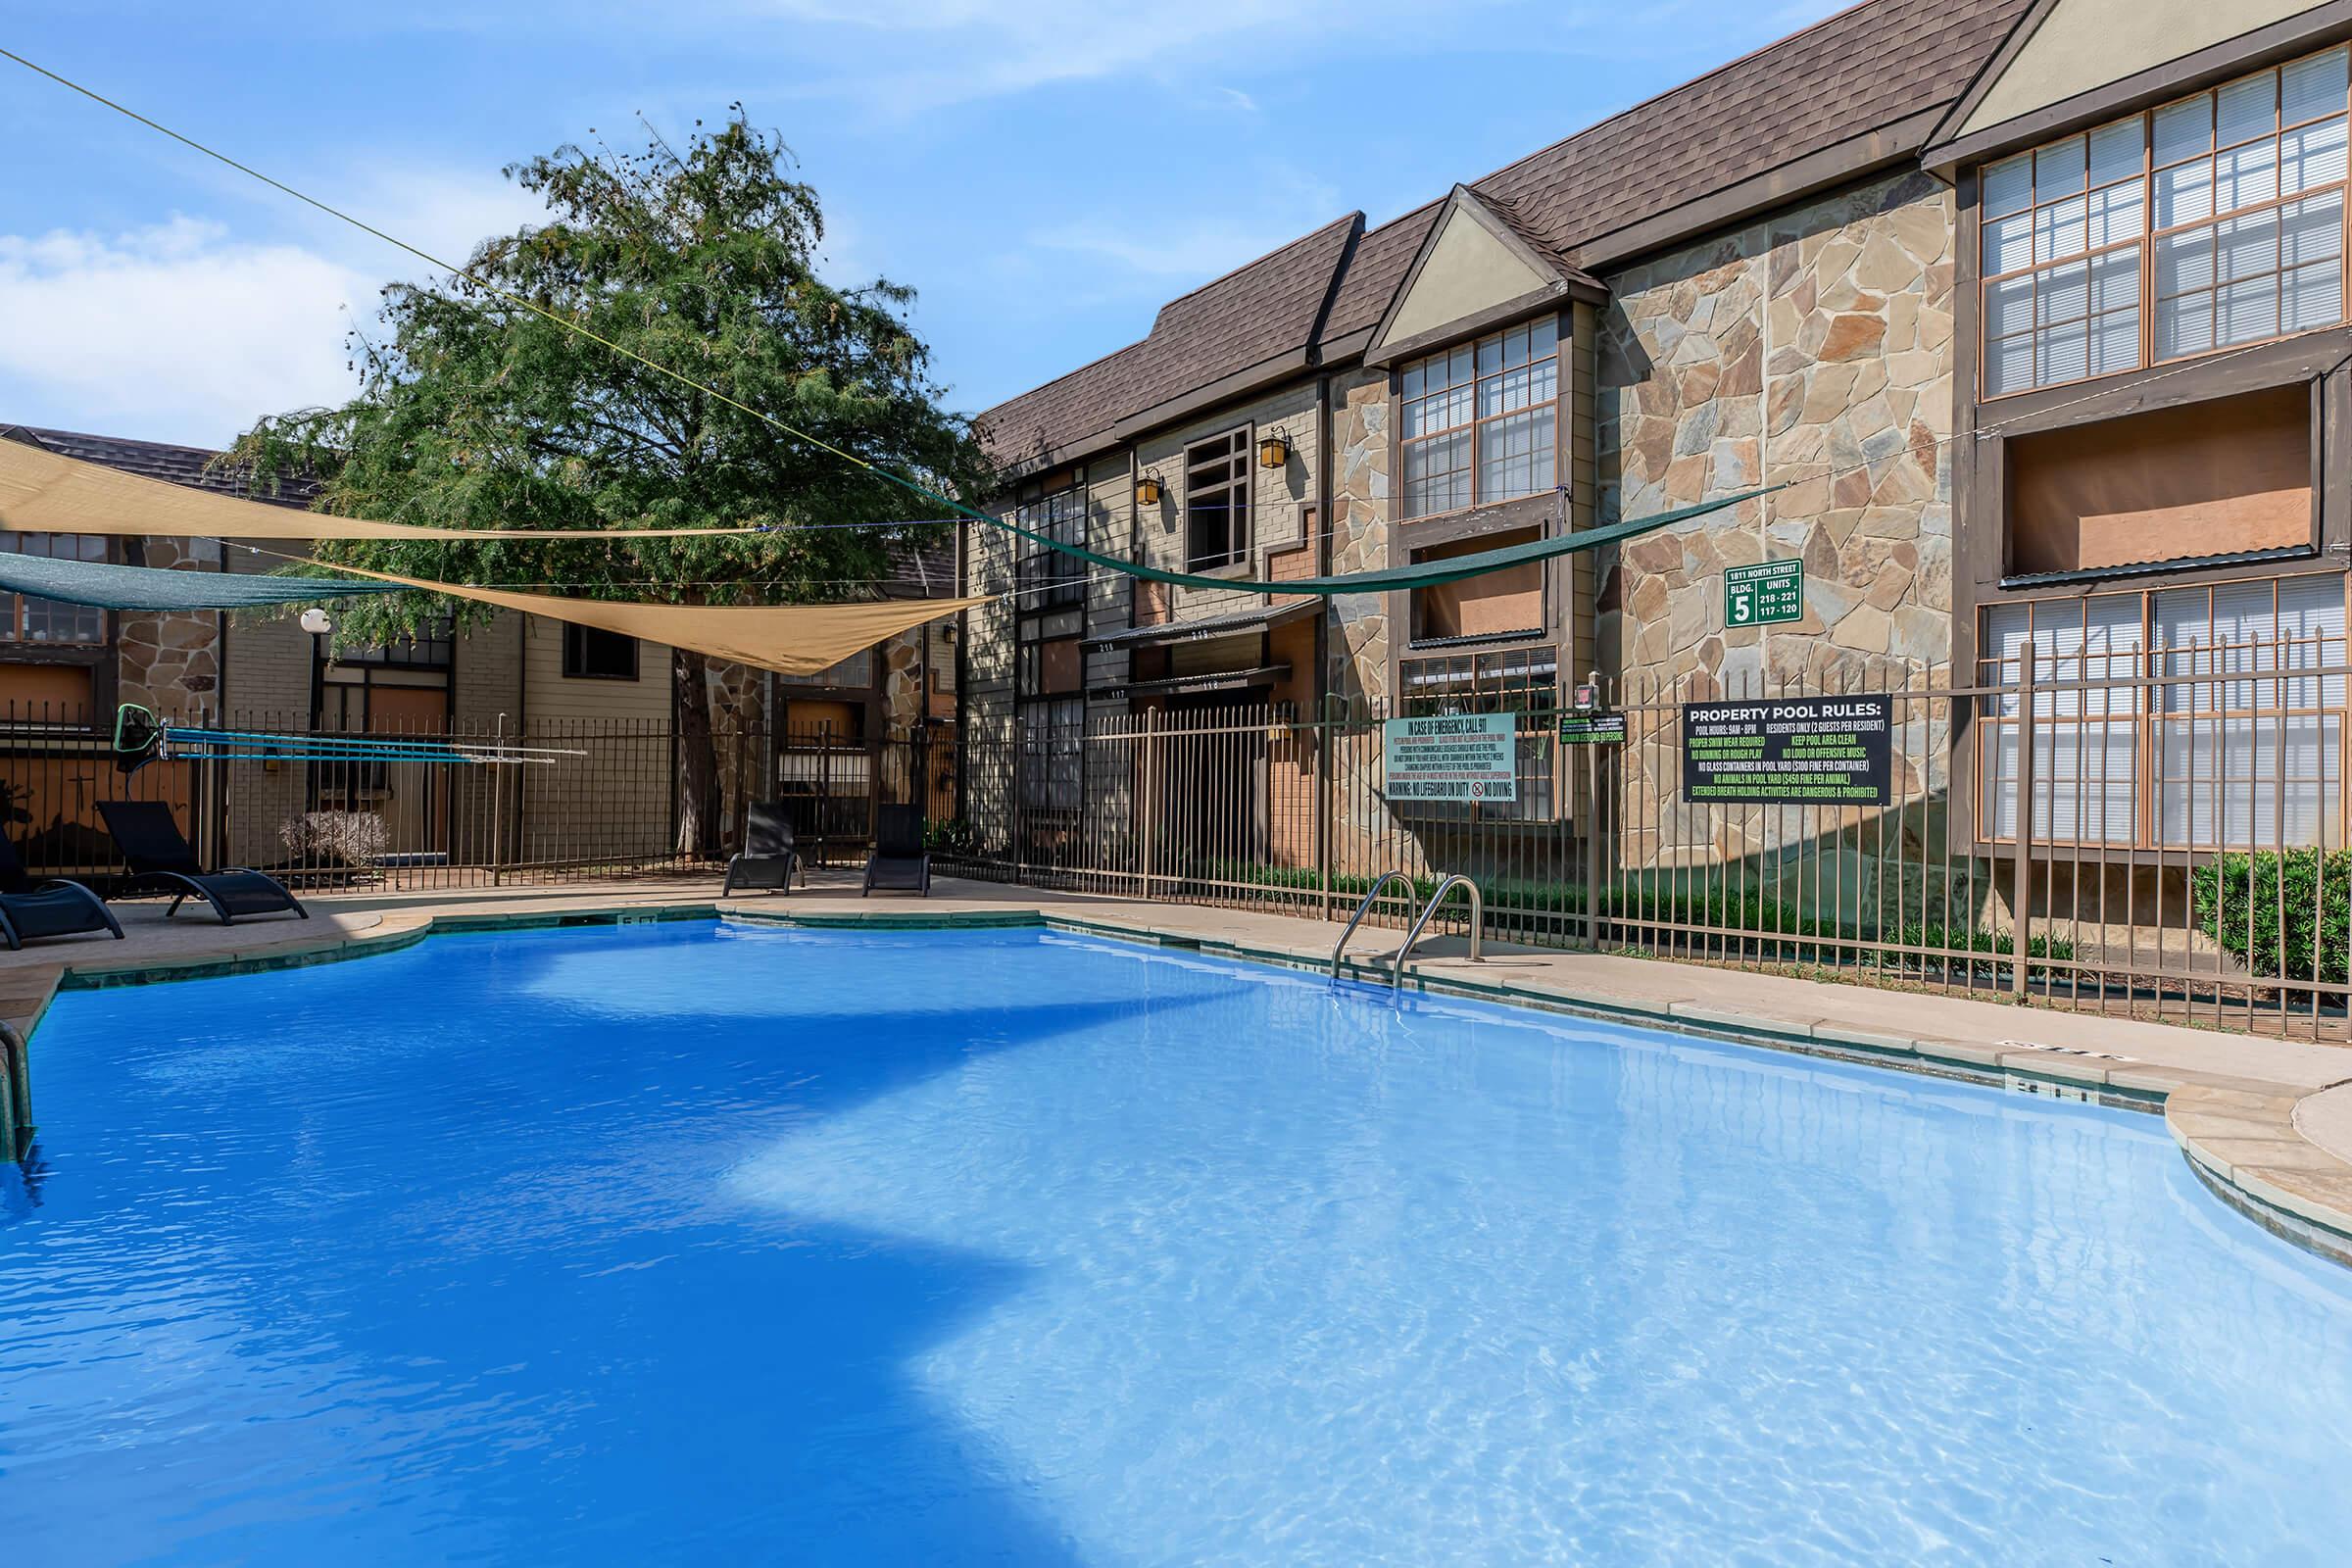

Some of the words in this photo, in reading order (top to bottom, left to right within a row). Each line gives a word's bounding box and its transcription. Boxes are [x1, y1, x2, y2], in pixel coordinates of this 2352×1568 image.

[1731, 571, 1746, 580] 1811
[1748, 568, 1771, 577] NORTH
[1773, 564, 1796, 574] STREET
[1732, 584, 1753, 594] BLDG.
[1767, 579, 1790, 589] UNITS
[1760, 594, 1775, 604] 218
[1782, 592, 1795, 602] 221
[1735, 596, 1749, 621] 5
[1761, 607, 1775, 616] 117
[1782, 605, 1796, 613] 120
[1192, 630, 1207, 640] 219
[1111, 690, 1124, 699] 117
[1690, 708, 1769, 721] PROPERTY
[1774, 706, 1818, 718] POOL
[1823, 704, 1881, 716] RULES:
[1408, 721, 1413, 735] IN
[1414, 721, 1427, 735] CASE
[1428, 720, 1434, 735] OF
[1435, 719, 1465, 734] EMERGENCY,
[1466, 718, 1478, 733] CALL
[1695, 725, 1708, 735] POOL
[1709, 725, 1728, 735] HOURS:
[1729, 724, 1740, 735] 9AM
[1767, 722, 1795, 733] RESIDENTS
[1796, 722, 1810, 732] ONLY
[1811, 721, 1818, 734] (2
[1819, 721, 1839, 732] GUESTS
[1841, 721, 1852, 731] PER
[1853, 719, 1885, 732] RESIDENT)
[1690, 738, 1707, 748] PROPER
[1709, 738, 1723, 747] SWIM
[1724, 737, 1739, 747] WEAR
[1740, 737, 1765, 747] REQUIRED
[1791, 736, 1805, 745] KEEP
[1806, 735, 1821, 745] POOL
[1822, 735, 1837, 745] AREA
[1838, 734, 1856, 745] CLEAN
[1691, 751, 1698, 760] NO
[1723, 750, 1730, 759] OR
[1731, 750, 1747, 759] ROUGH
[1749, 749, 1763, 759] PLAY
[1783, 749, 1790, 759] NO
[1792, 749, 1806, 759] LOUD
[1807, 748, 1815, 758] OR
[1816, 748, 1846, 758] OFFENSIVE
[1847, 747, 1866, 758] MUSIC
[1698, 762, 1705, 772] NO
[1706, 762, 1723, 771] GLASS
[1724, 761, 1754, 771] CONTAINERS
[1755, 761, 1761, 771] IN
[1762, 761, 1776, 771] POOL
[1778, 761, 1791, 771] YARD
[1792, 760, 1808, 772] ($100
[1809, 760, 1822, 770] FINE
[1823, 760, 1834, 770] PER
[1835, 760, 1869, 772] CONTAINER)
[1714, 774, 1721, 784] NO
[1722, 774, 1744, 784] ANIMALS
[1746, 774, 1751, 784] IN
[1753, 774, 1767, 784] POOL
[1767, 774, 1782, 784] YARD
[1800, 774, 1813, 784] FINE
[1814, 773, 1825, 784] PER
[1826, 773, 1850, 785] ANIMAL)
[1413, 782, 1419, 796] NO
[1421, 782, 1446, 796] LIFEGUARD
[1448, 782, 1454, 796] ON
[1456, 782, 1469, 796] DUTY
[1485, 782, 1492, 797] NO
[1494, 782, 1512, 797] DIVING
[1692, 786, 1716, 796] EXTENDED
[1717, 786, 1737, 796] BREATH
[1737, 786, 1760, 797] HOLDING
[1761, 787, 1789, 797] ACTIVITIES
[1790, 787, 1801, 797] ARE
[1803, 787, 1836, 797] DANGEROUS
[1838, 787, 1841, 797] &
[1843, 787, 1878, 798] PROHIBITED
